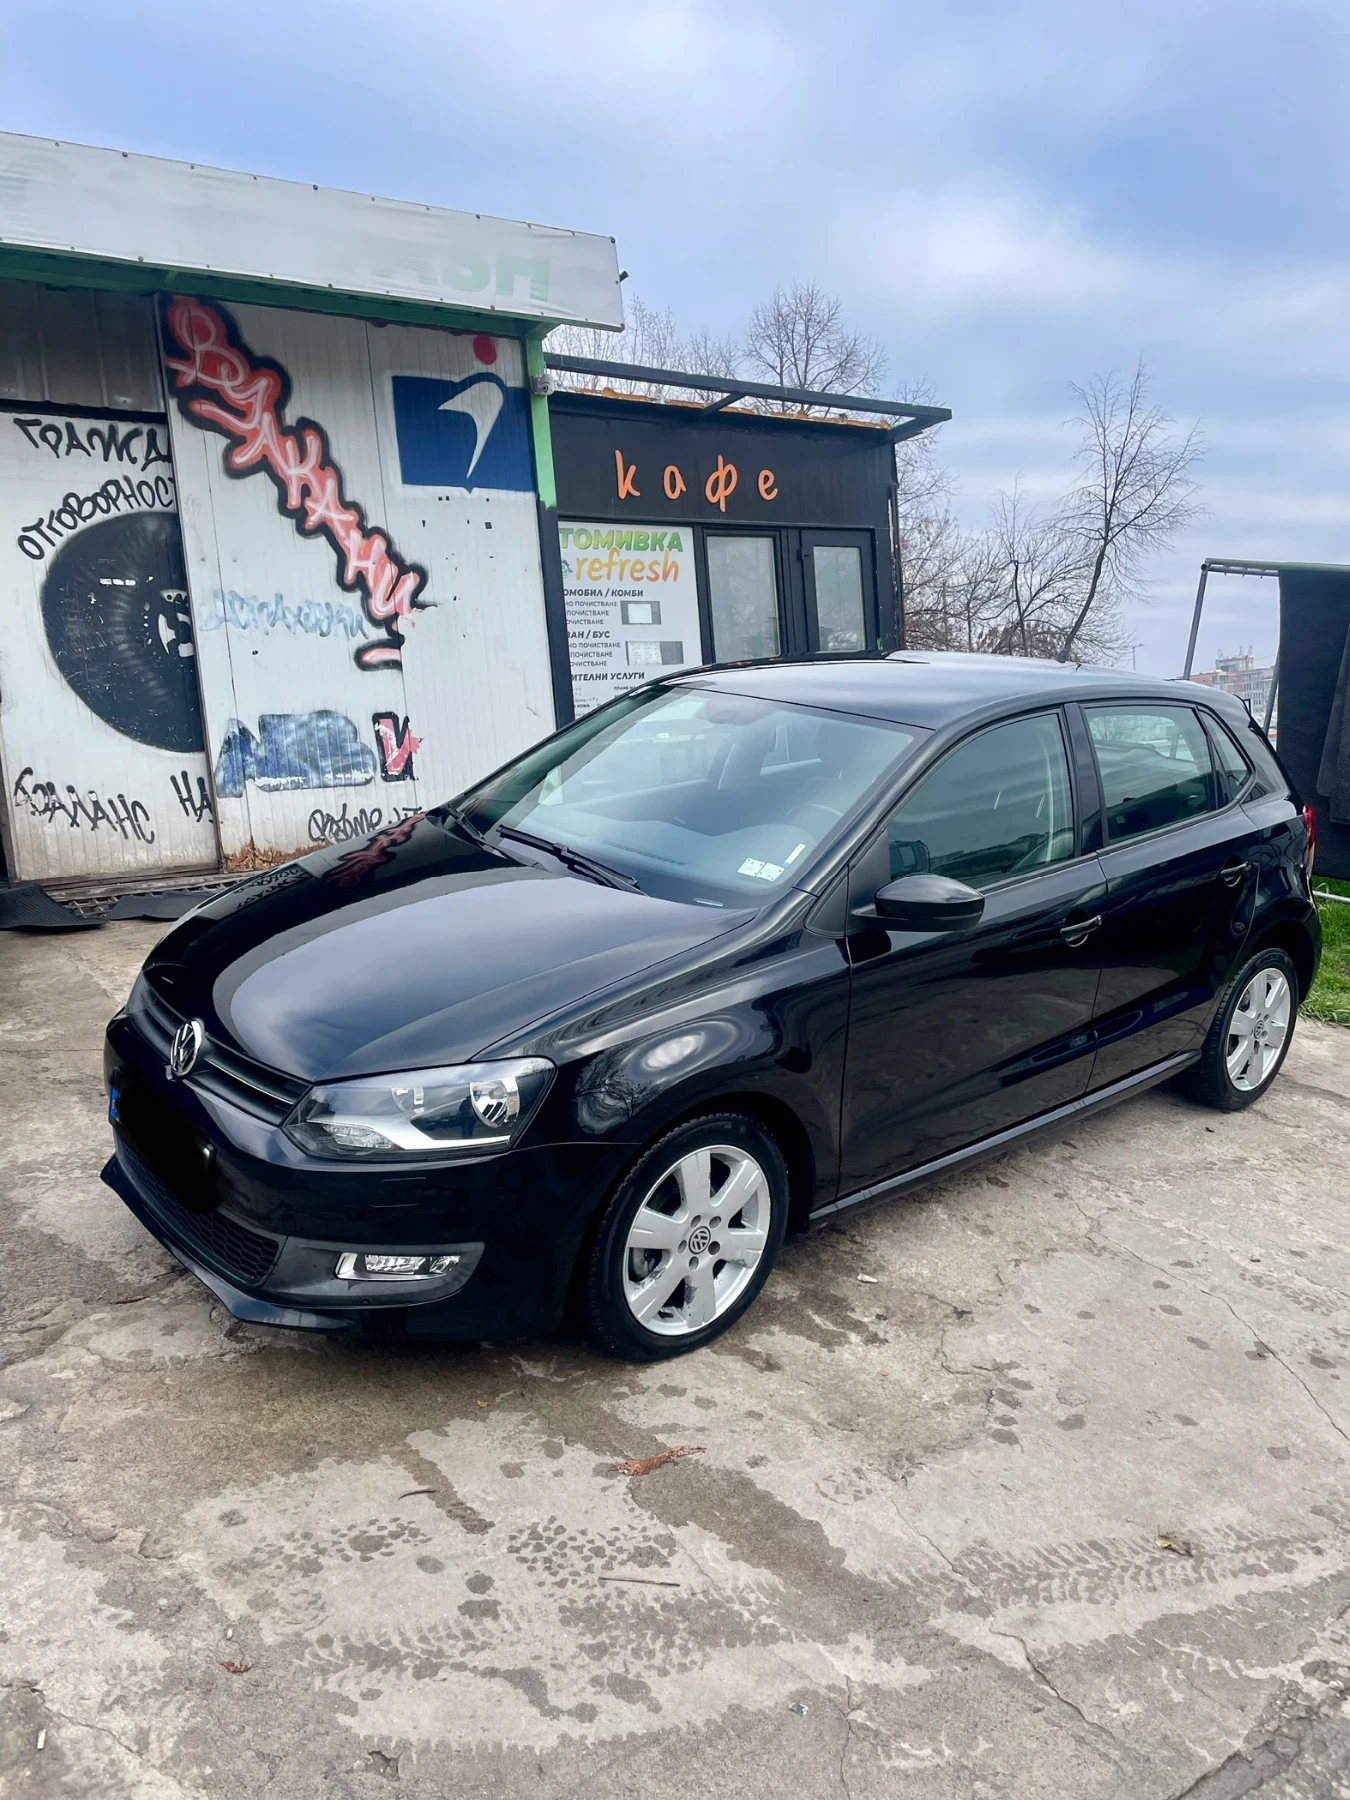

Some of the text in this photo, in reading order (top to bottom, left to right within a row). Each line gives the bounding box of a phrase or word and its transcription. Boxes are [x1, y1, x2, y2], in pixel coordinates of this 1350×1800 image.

[614, 449, 779, 513] кафе
[17, 475, 176, 560] ОТГОВОРНОС
[558, 527, 684, 552] ТОМИВКА
[575, 546, 680, 582] refresh
[611, 589, 644, 597] КОМБИ
[592, 630, 611, 639] БУС
[610, 672, 645, 680] УСЛУГИ
